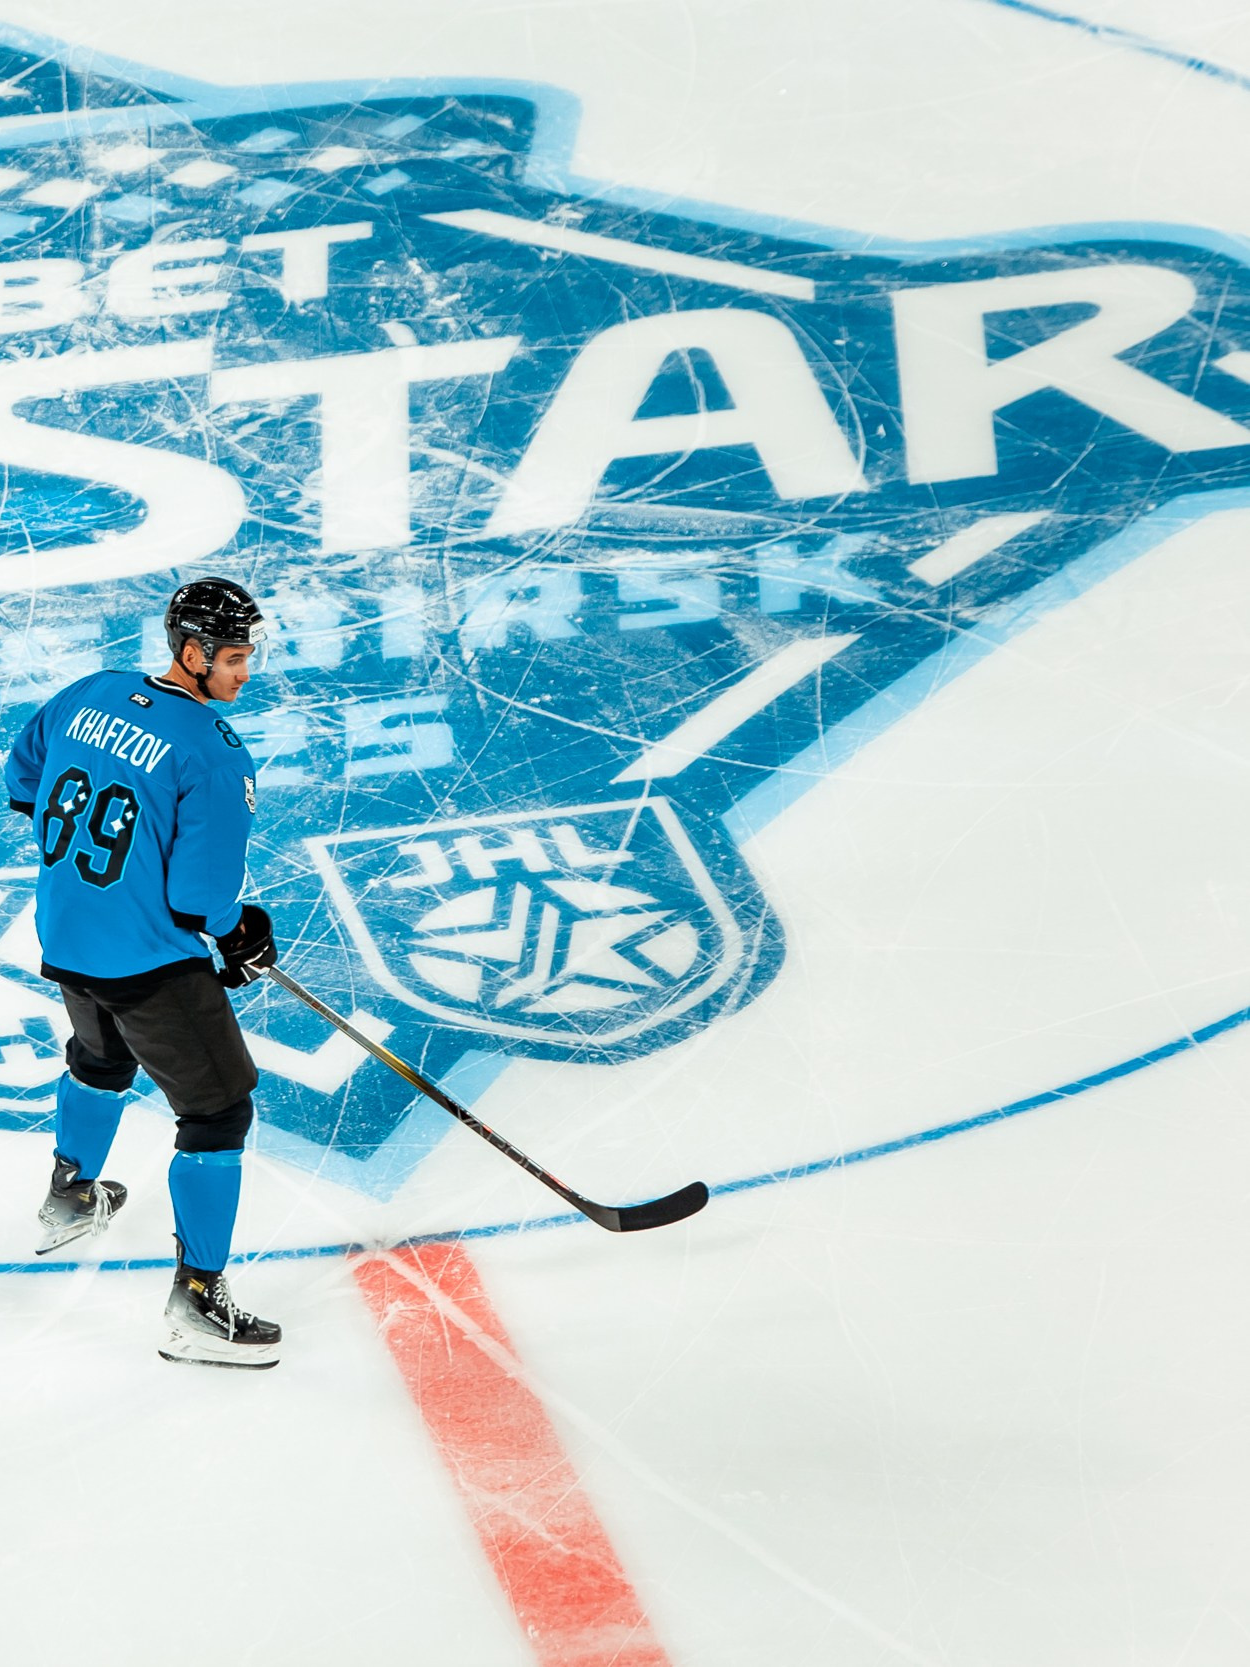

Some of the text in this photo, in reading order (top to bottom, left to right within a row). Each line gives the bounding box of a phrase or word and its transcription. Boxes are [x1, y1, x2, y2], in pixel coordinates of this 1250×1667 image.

[180, 620, 203, 633] CCM
[65, 707, 172, 774] KHAFIZOV
[41, 763, 143, 892] 89
[385, 824, 635, 889] JHL
